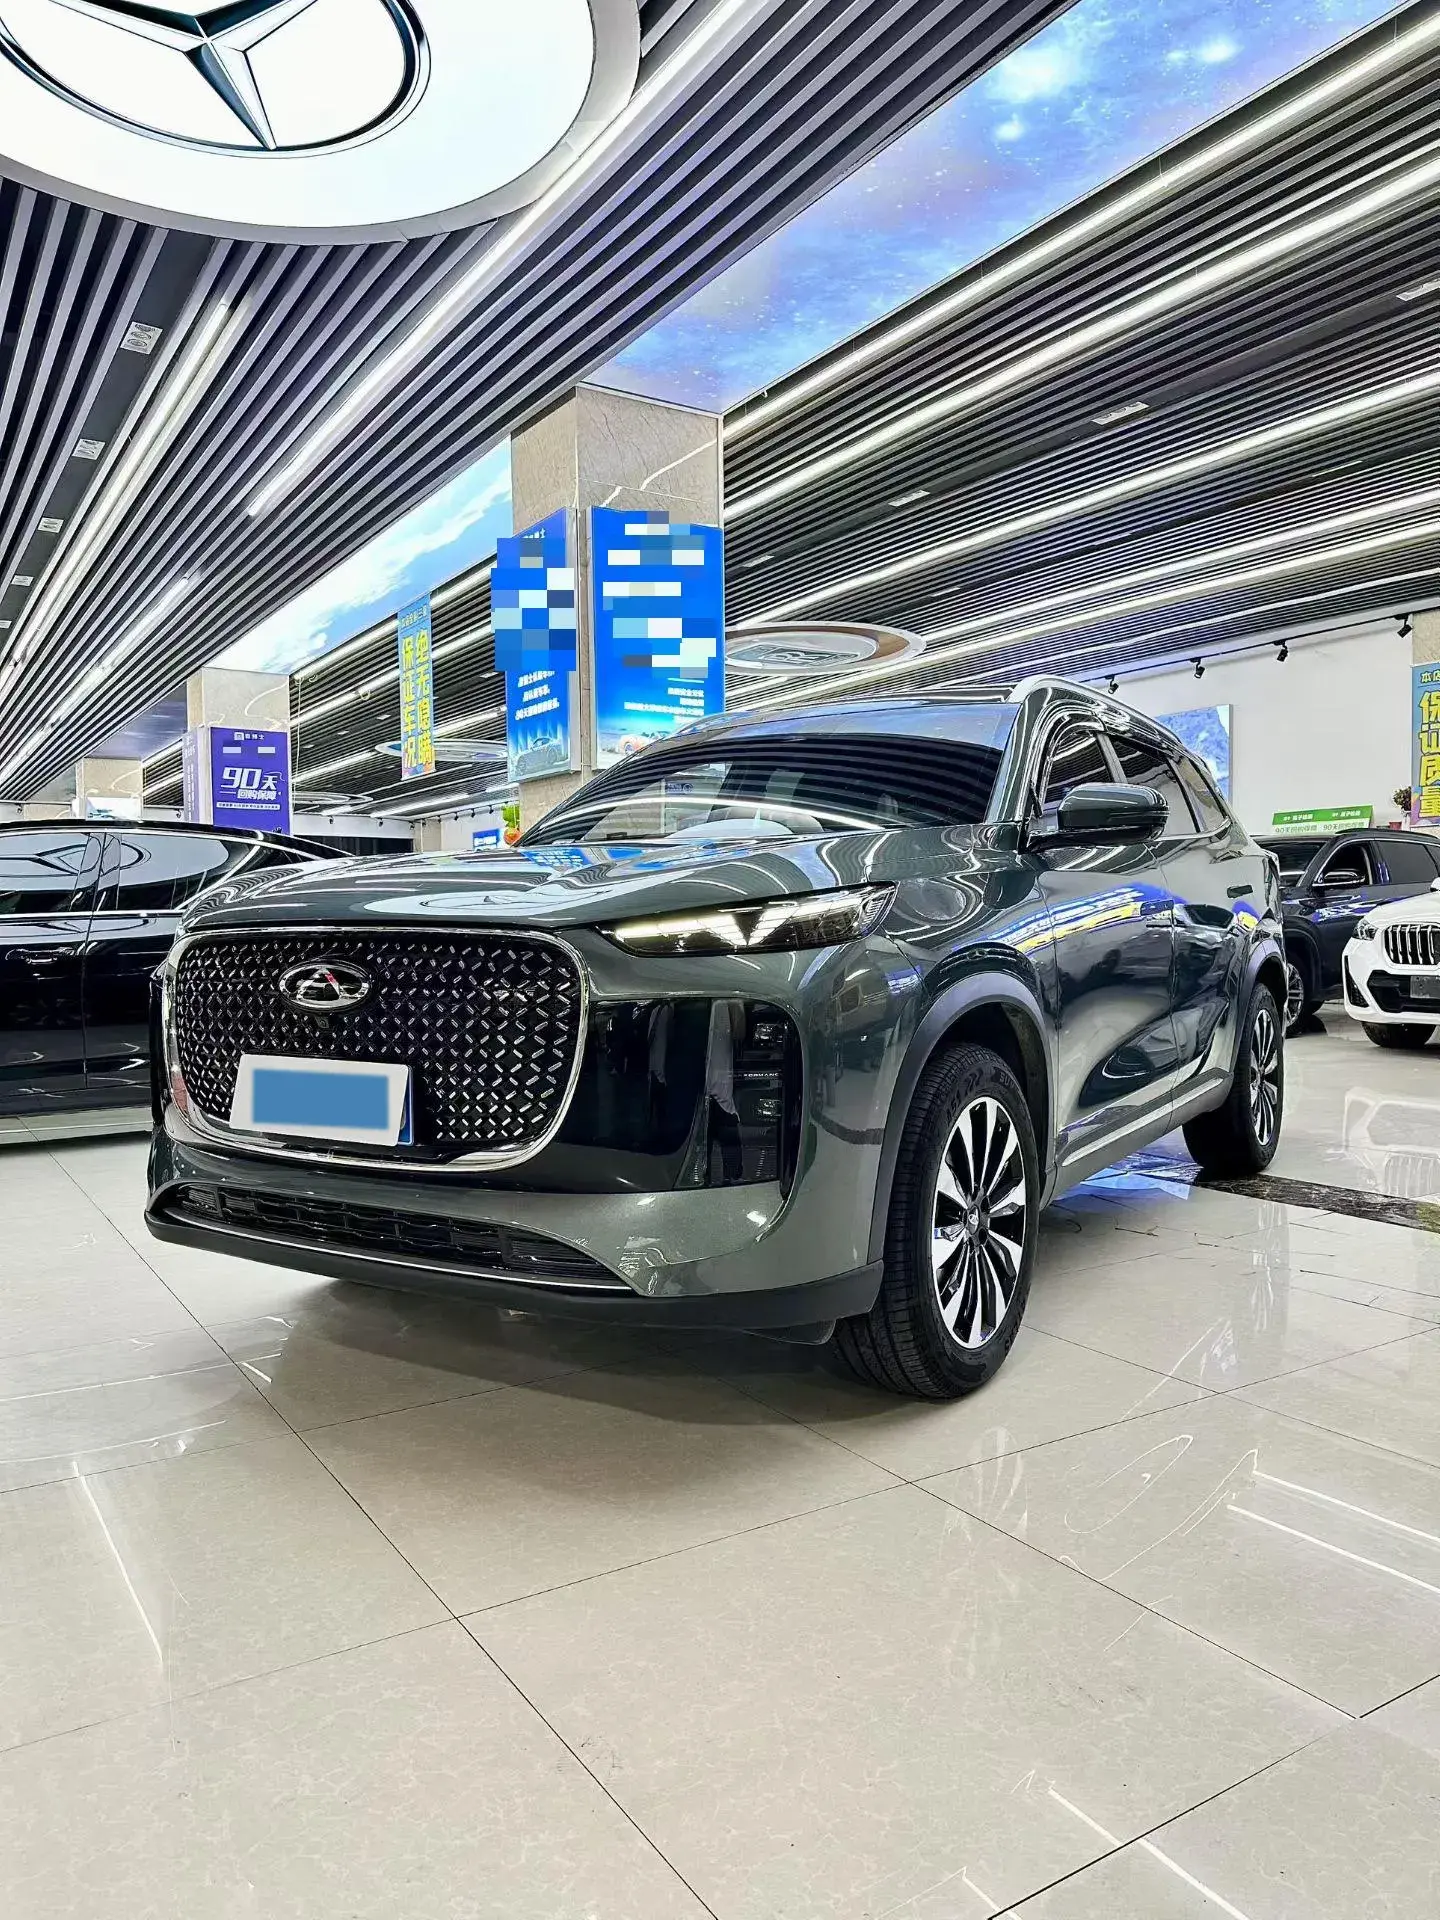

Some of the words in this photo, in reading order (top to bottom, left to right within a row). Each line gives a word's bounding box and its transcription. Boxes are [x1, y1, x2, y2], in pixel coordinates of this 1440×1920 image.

[220, 766, 278, 790] 90天
[236, 788, 277, 801] 回购保障
